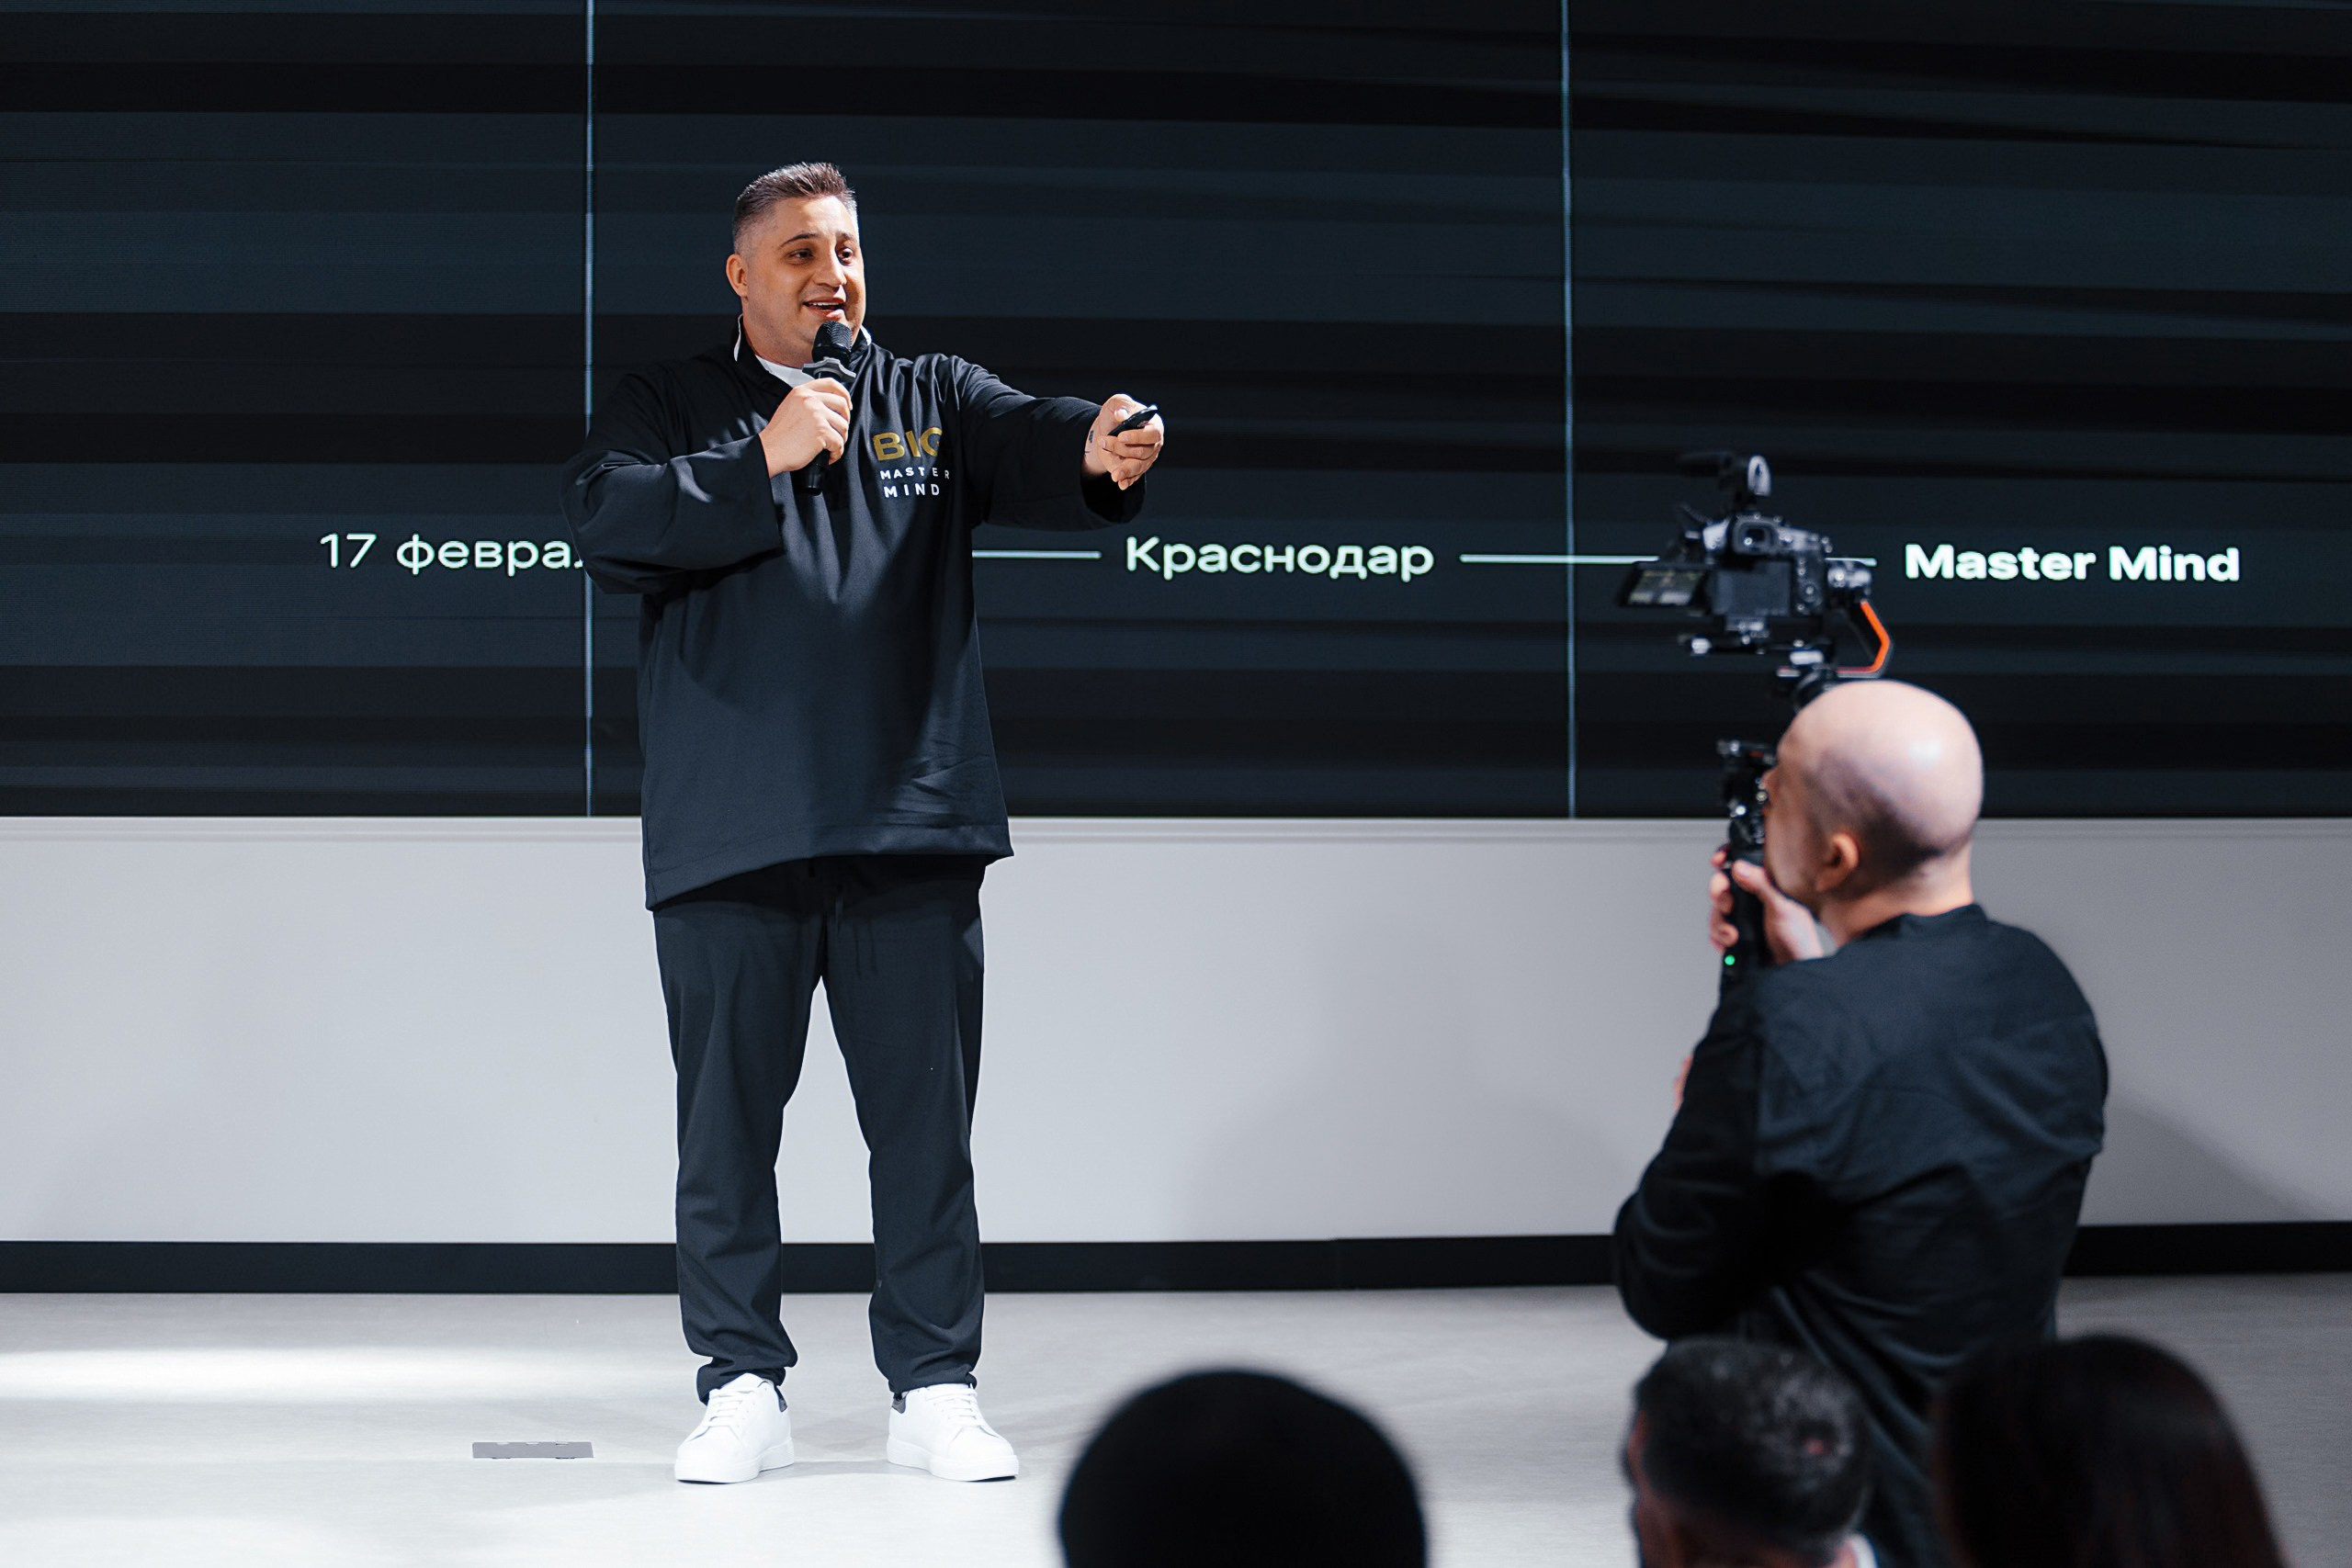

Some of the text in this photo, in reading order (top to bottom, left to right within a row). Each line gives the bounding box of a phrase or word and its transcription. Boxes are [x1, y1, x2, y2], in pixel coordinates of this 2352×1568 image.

[879, 466, 950, 480] MASTER
[883, 483, 940, 498] MIND
[320, 533, 584, 577] 17 февра
[1126, 536, 1434, 583] Краснодар
[1905, 543, 2240, 581] Master Mind
